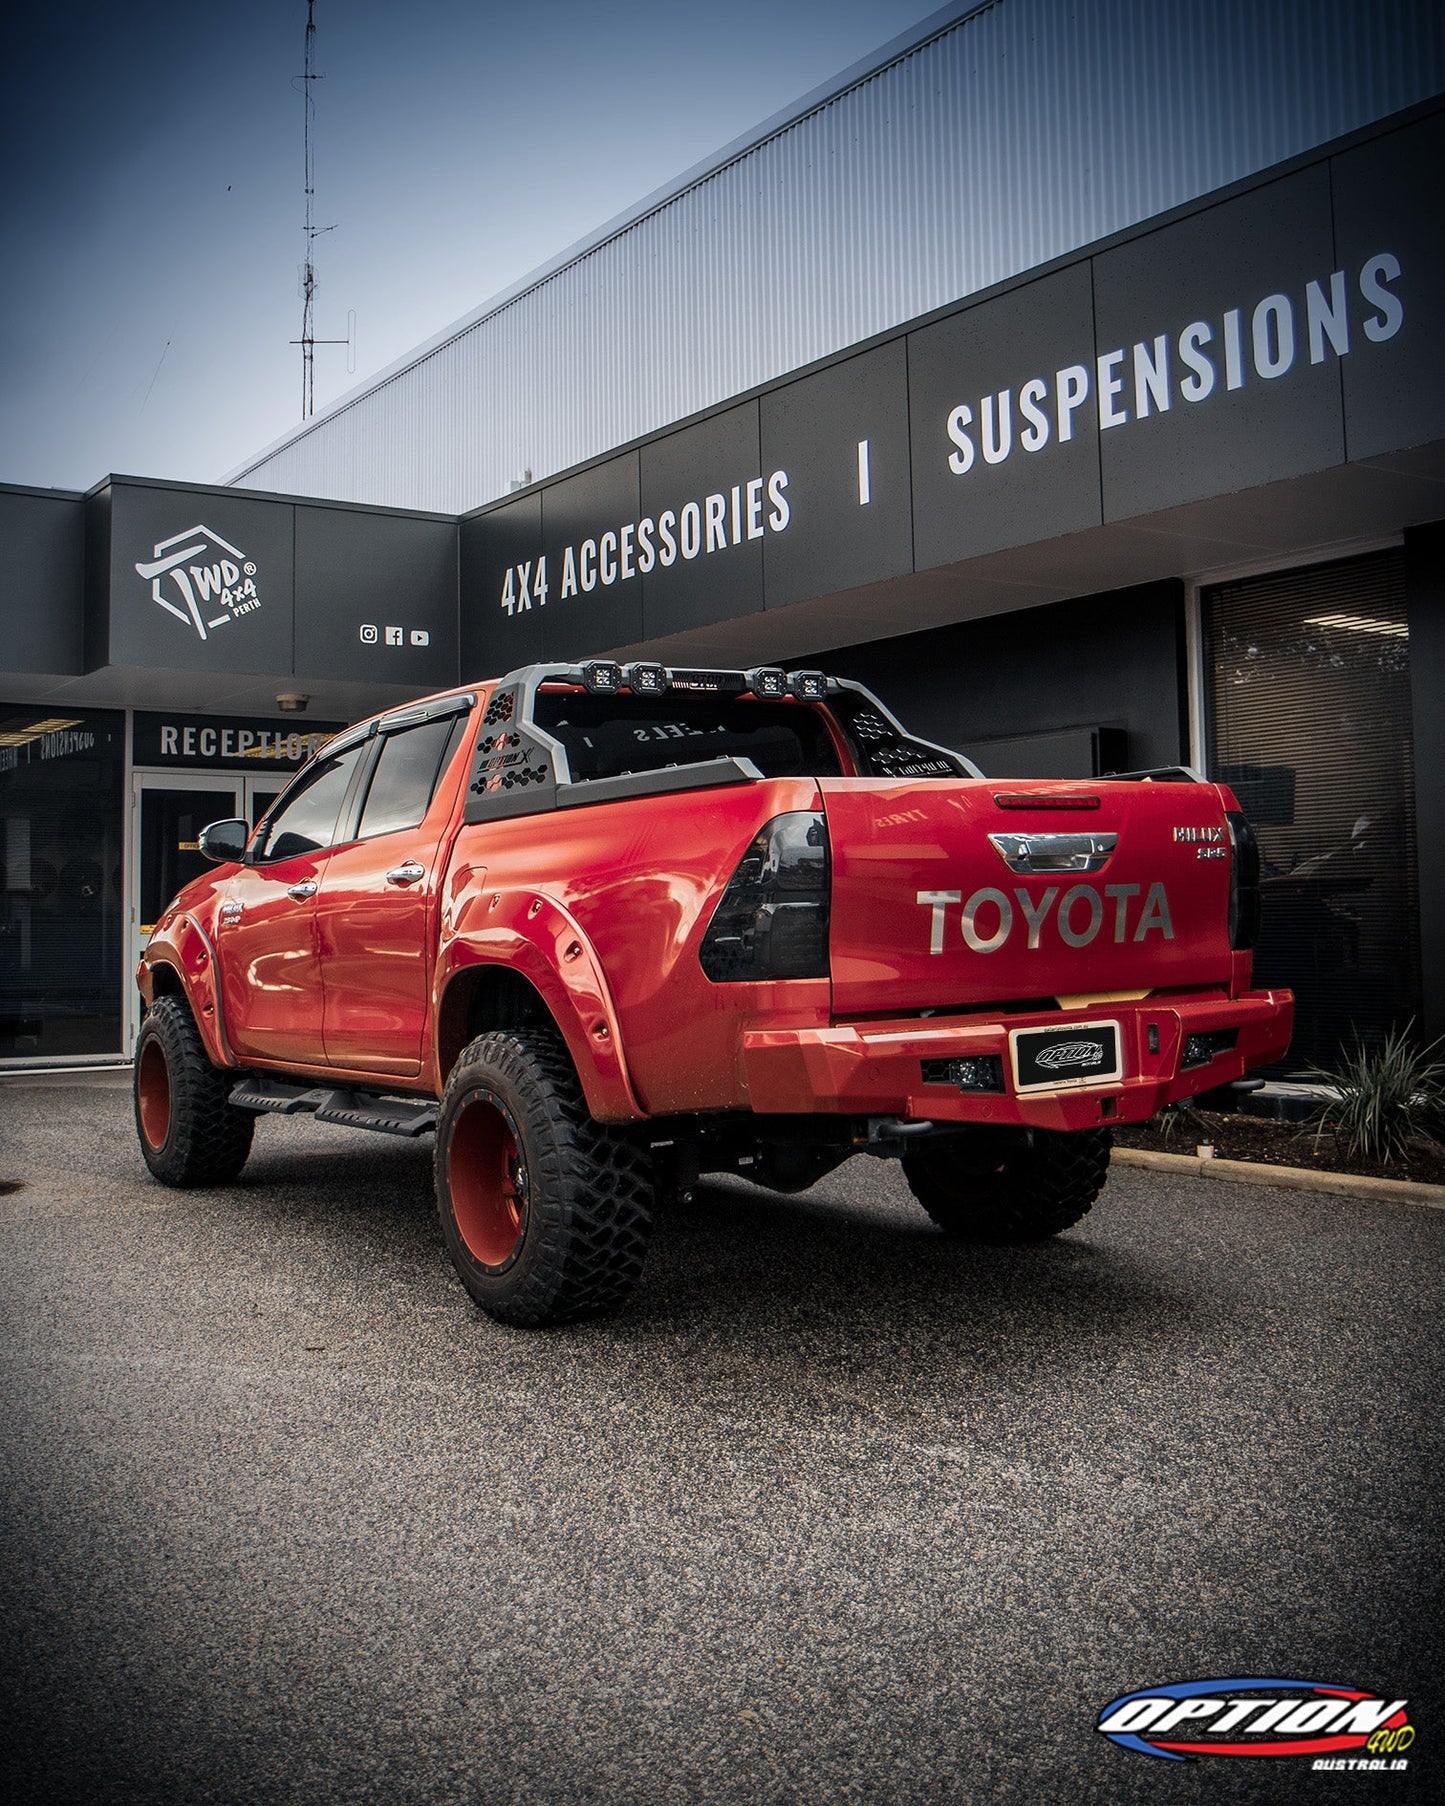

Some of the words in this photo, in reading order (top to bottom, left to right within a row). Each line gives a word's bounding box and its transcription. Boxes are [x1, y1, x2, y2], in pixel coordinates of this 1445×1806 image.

[501, 555, 550, 617] 4X4
[561, 470, 792, 601] ACCESSORIES
[946, 252, 1405, 476] SUSPENSIONS
[220, 578, 257, 607] 4x4
[232, 597, 262, 618] PERTH
[1173, 827, 1224, 842] HILUX
[1197, 847, 1226, 859] SR5
[916, 882, 1175, 955] TOYOTA
[1036, 1044, 1102, 1063] OPTION
